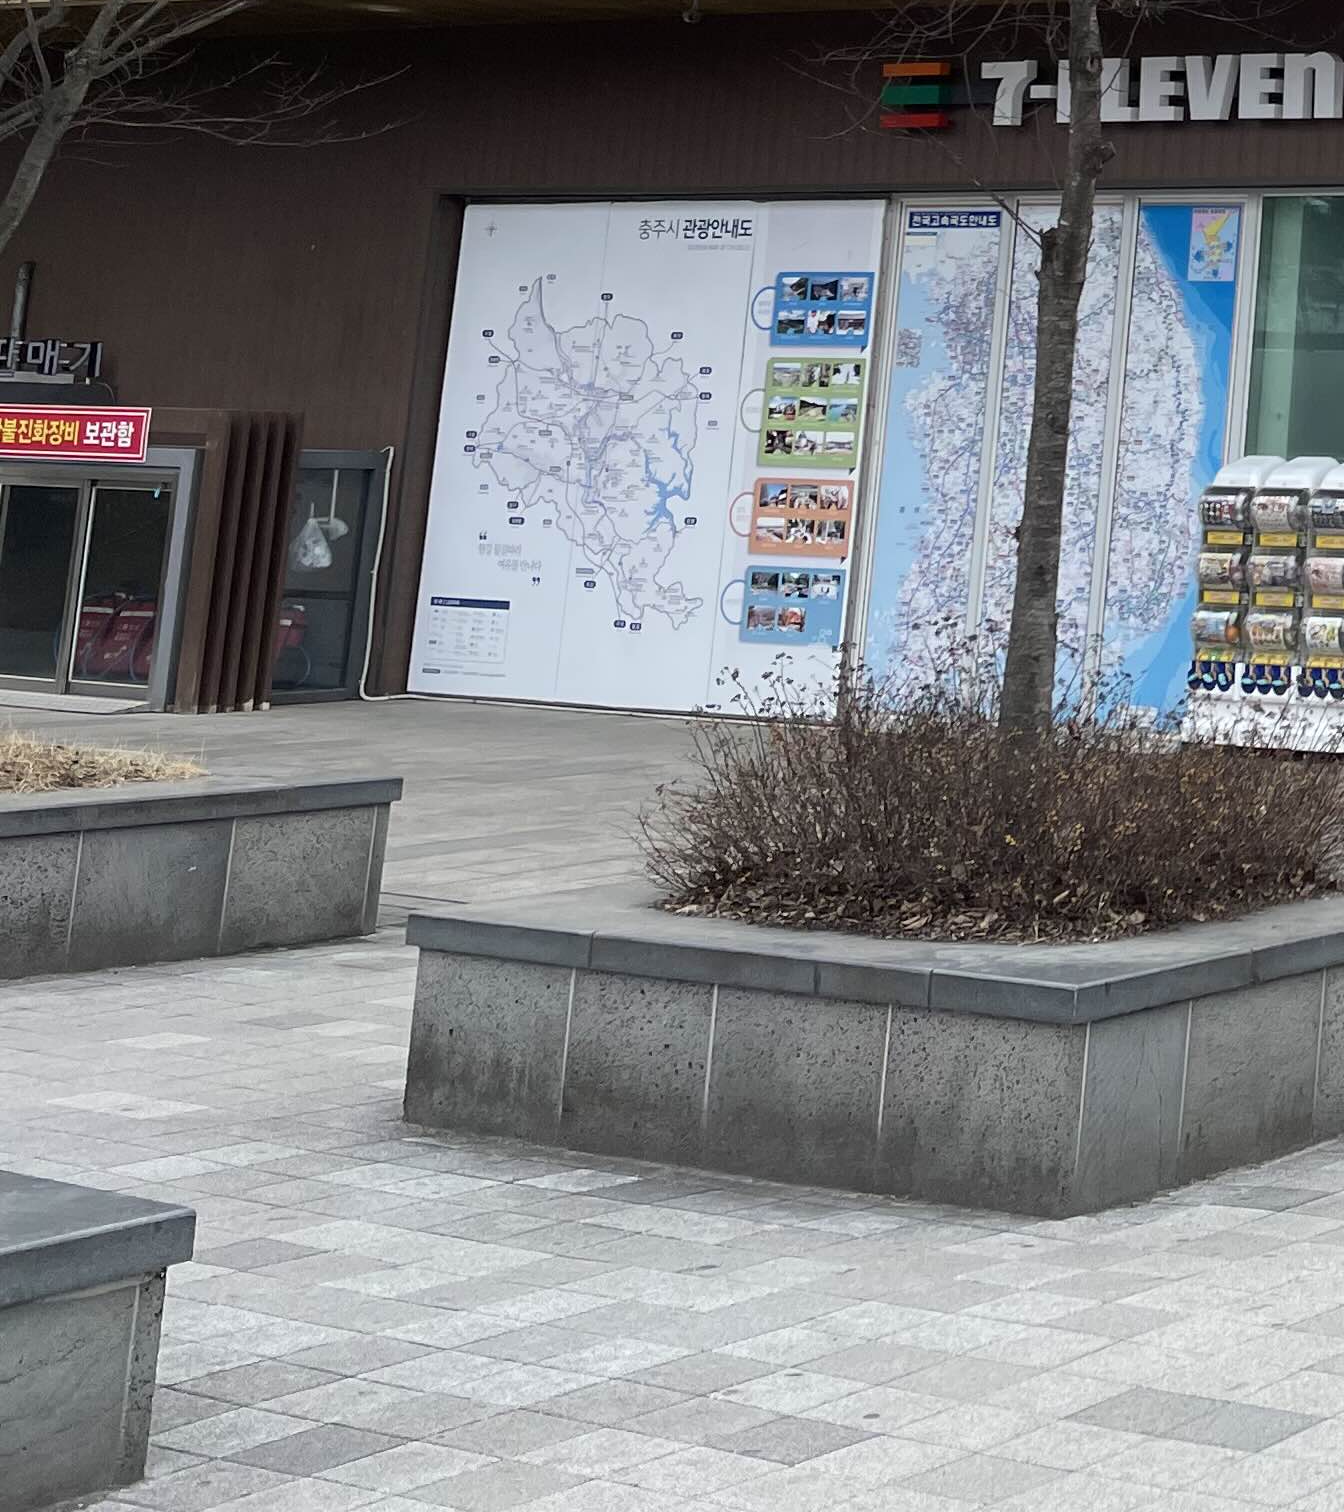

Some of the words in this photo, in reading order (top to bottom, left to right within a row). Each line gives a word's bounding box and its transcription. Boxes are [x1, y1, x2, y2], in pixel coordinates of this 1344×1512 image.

[638, 218, 680, 240] 충주시
[682, 218, 753, 240] 관광안내도
[0, 417, 80, 446] 불진화장비
[83, 420, 135, 448] 보관함
